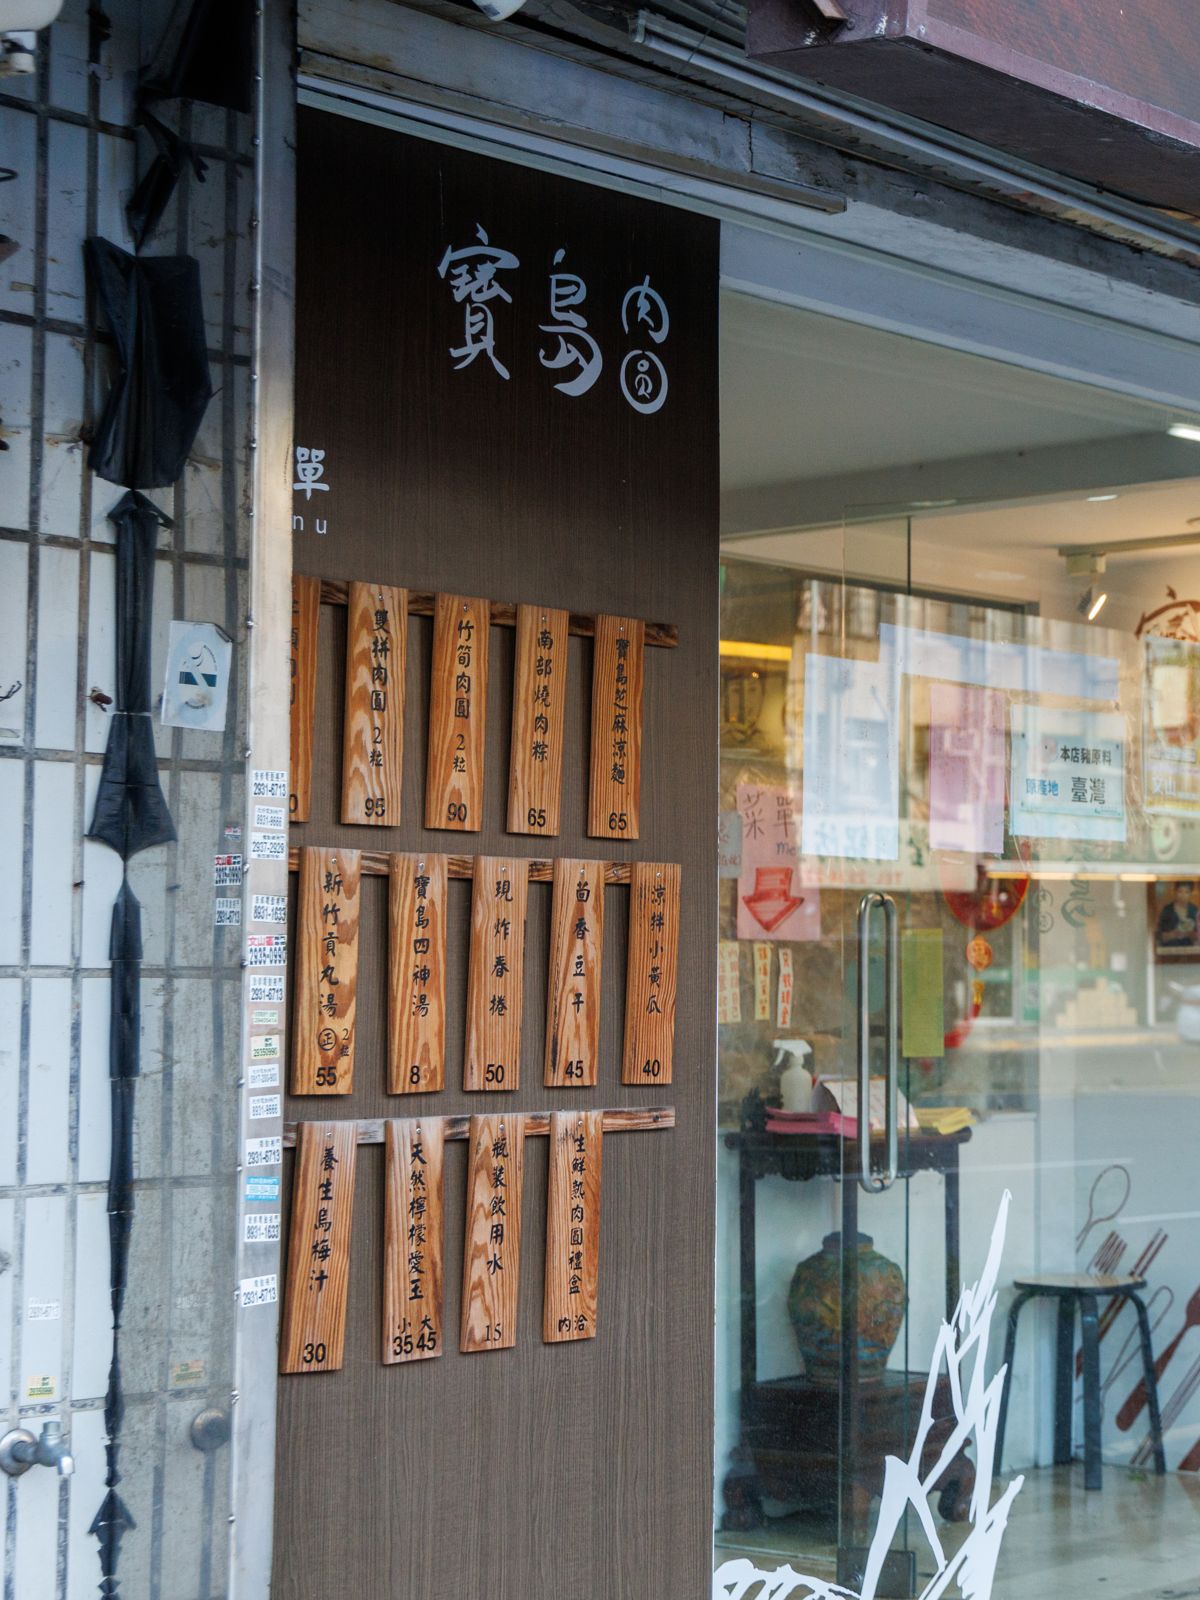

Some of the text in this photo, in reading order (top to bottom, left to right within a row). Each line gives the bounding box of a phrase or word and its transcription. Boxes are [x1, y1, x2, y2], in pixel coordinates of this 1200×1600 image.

[438, 223, 670, 414] 寶島肉圓
[532, 629, 553, 762] 南部燒肉粽
[1071, 776, 1106, 805] 臺灣
[364, 797, 386, 818] 95
[447, 803, 468, 823] 90
[527, 808, 547, 828] 65
[608, 812, 628, 831] 65
[319, 871, 344, 1018] 新竹貢丸湯
[411, 875, 431, 1018] 寶島四神湯
[489, 880, 514, 1016] 現炸春捲
[645, 884, 667, 1015] 涼拌小黃瓜
[315, 1066, 337, 1086] 55
[485, 1064, 505, 1084] 50
[565, 1060, 584, 1079] 45
[642, 1059, 661, 1078] 40
[486, 1136, 509, 1275] 瓶裝飲用水
[309, 1145, 339, 1293] 養生烏梅汁
[408, 1143, 427, 1300] 天然檸檬愛玉
[419, 1314, 434, 1331] 大
[484, 1323, 502, 1342] 15
[303, 1343, 327, 1364] 30
[393, 1331, 437, 1356] 35 45
